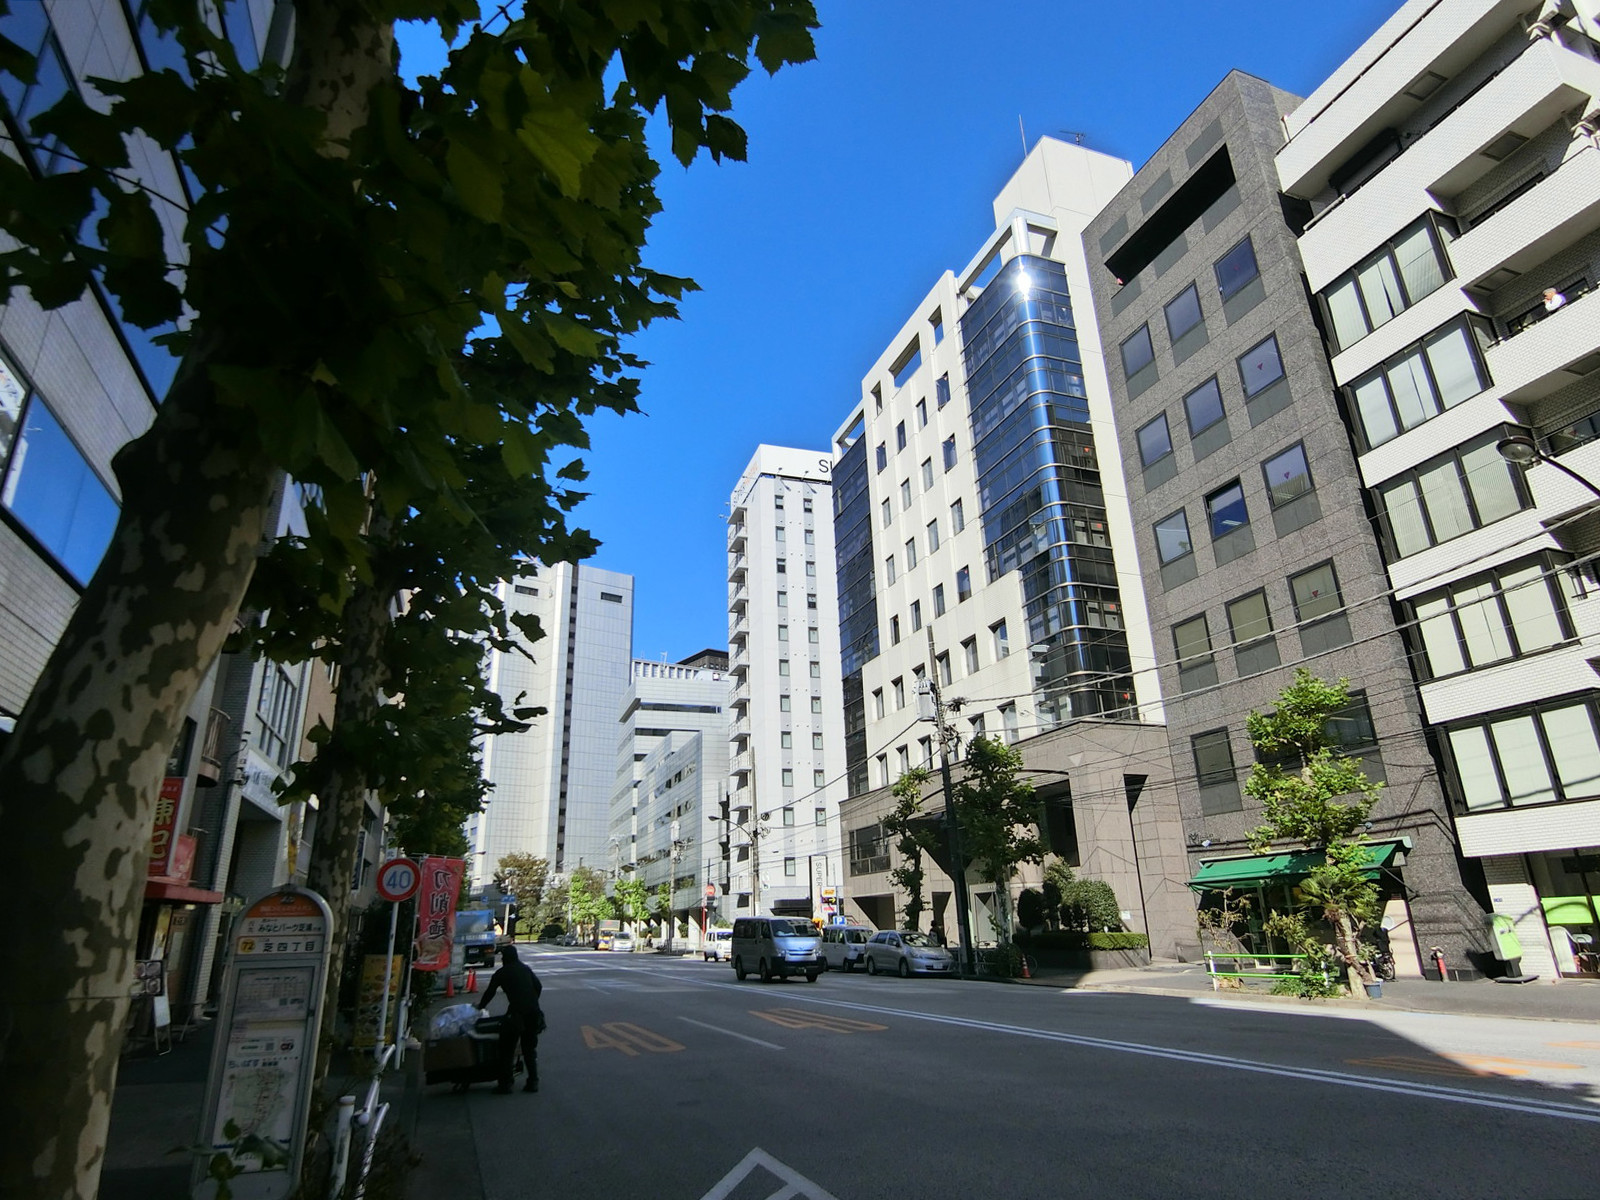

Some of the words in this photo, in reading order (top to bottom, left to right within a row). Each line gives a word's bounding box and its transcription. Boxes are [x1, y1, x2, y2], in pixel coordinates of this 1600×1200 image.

[386, 870, 411, 889] 40
[815, 862, 823, 887] SUPER
[242, 941, 254, 950] 72
[263, 941, 315, 953] 芝四丁目
[581, 1021, 687, 1057] 40
